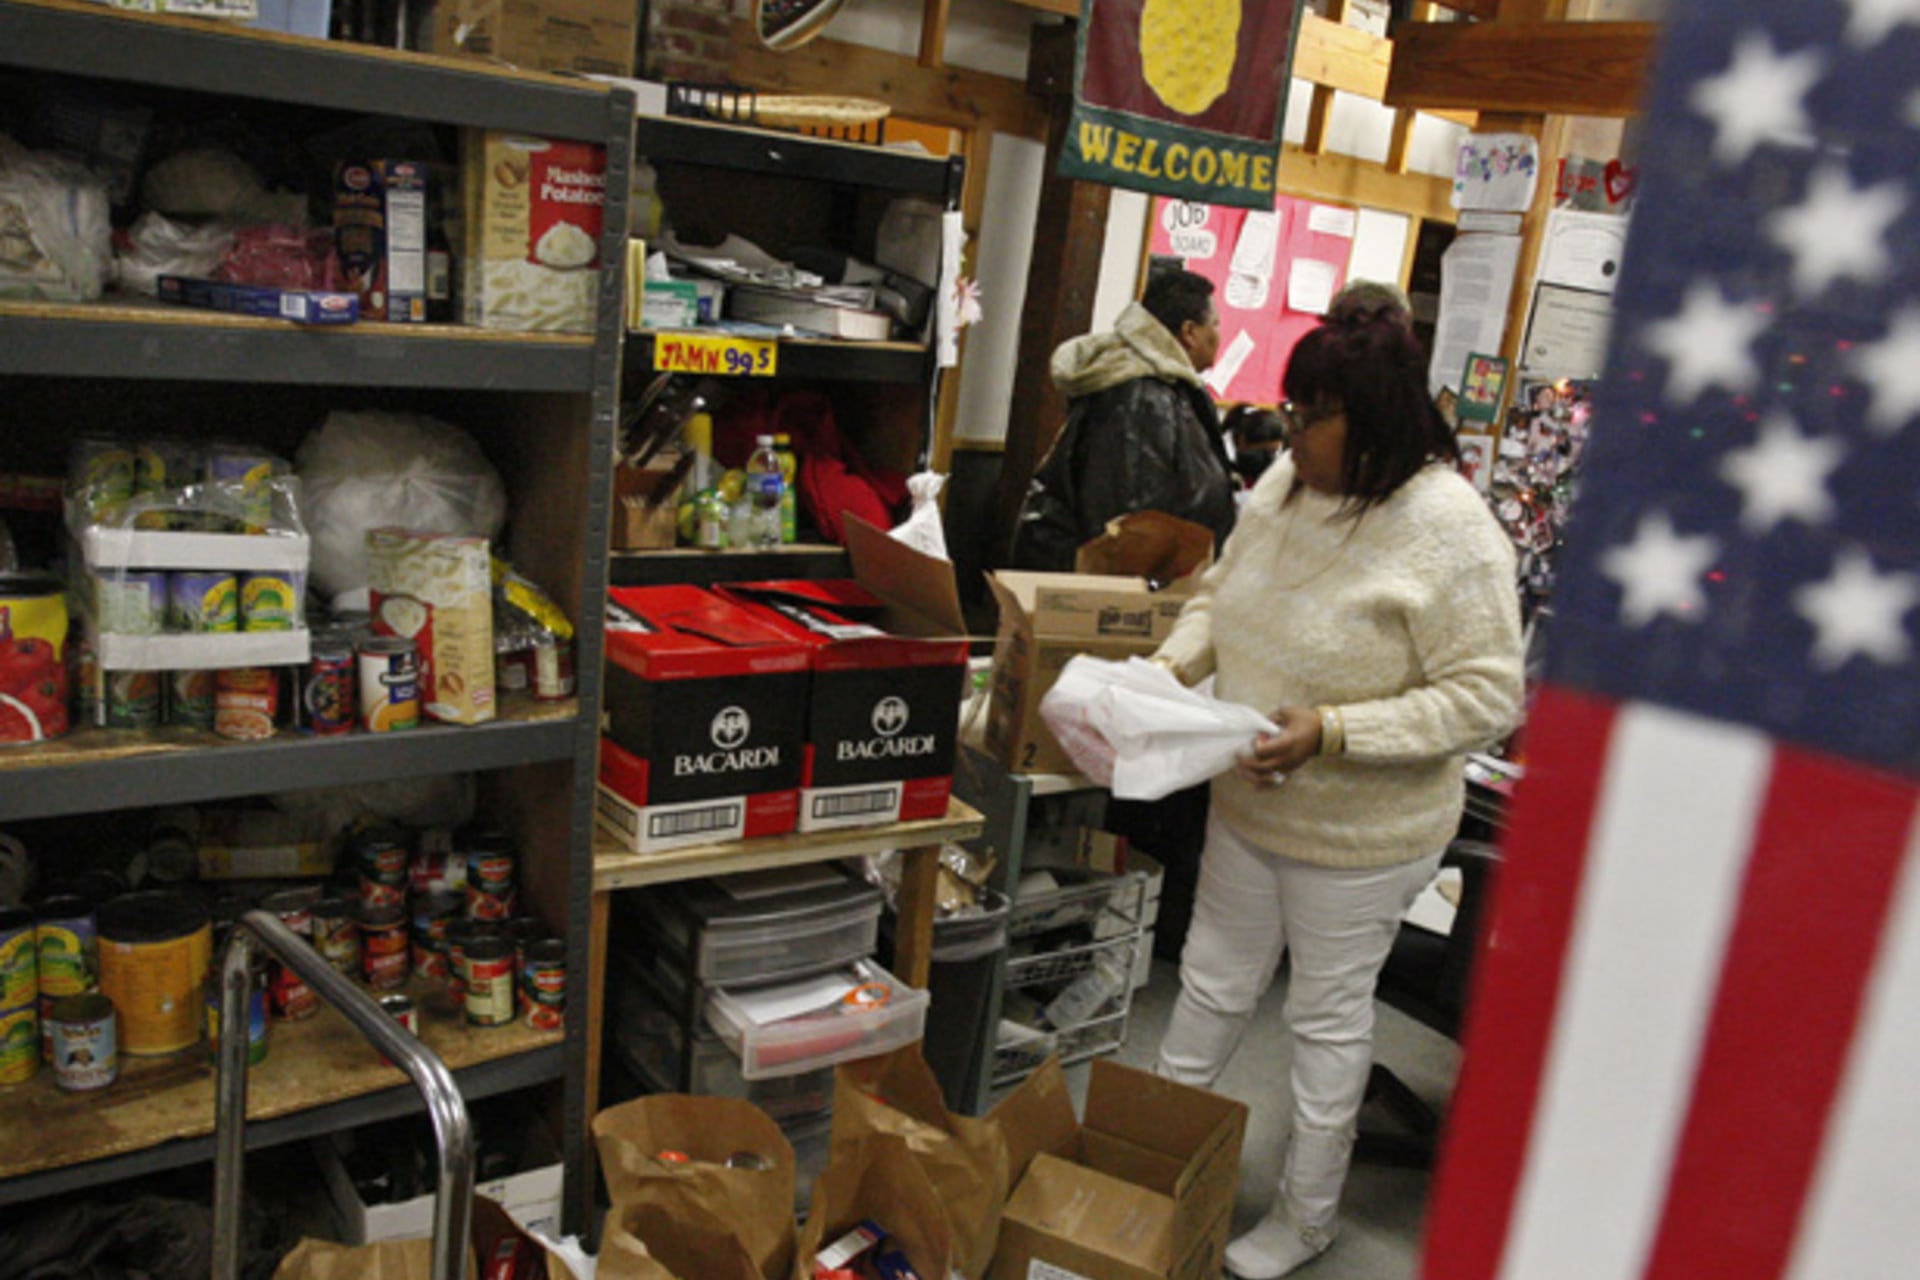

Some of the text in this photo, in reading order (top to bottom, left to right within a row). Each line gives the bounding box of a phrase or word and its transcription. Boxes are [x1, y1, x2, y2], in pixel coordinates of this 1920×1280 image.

[1079, 121, 1273, 191] WELCOME
[673, 746, 780, 776] BACARDI
[836, 735, 936, 760] BACARDI
